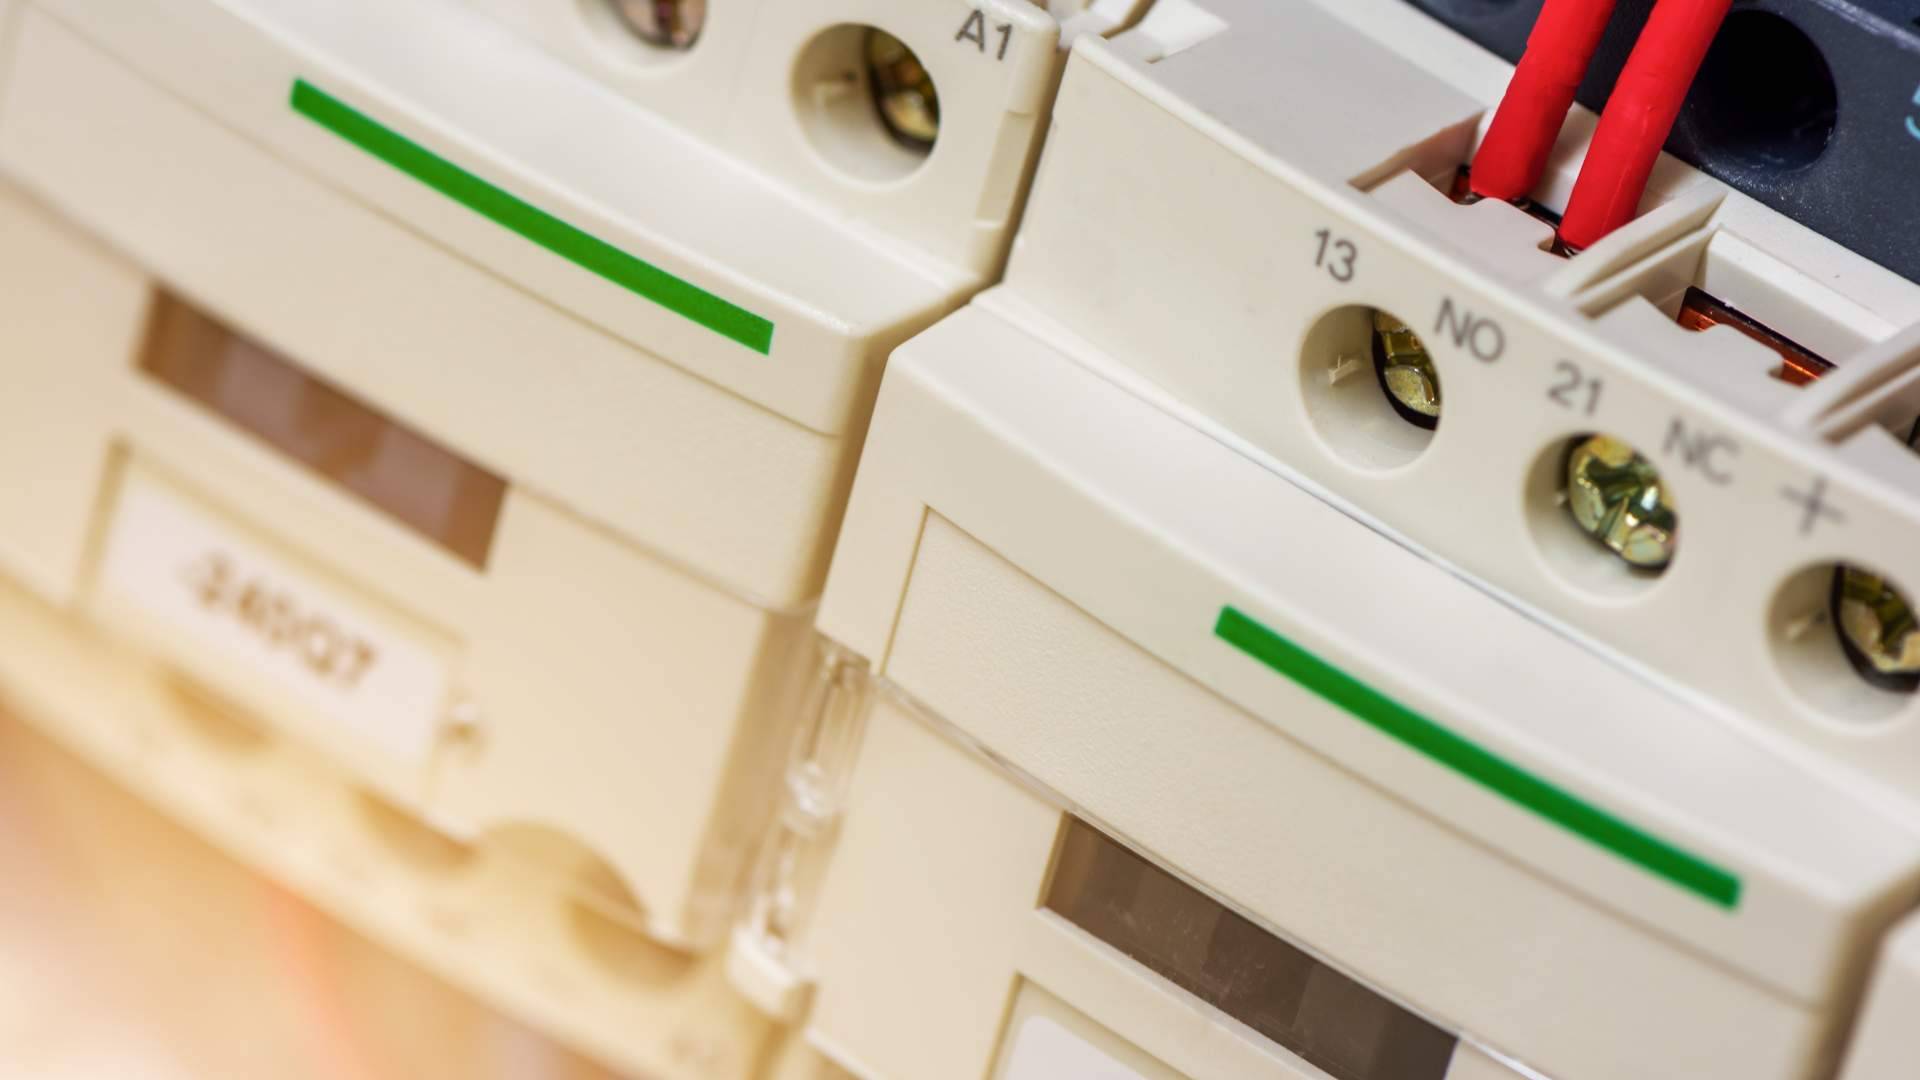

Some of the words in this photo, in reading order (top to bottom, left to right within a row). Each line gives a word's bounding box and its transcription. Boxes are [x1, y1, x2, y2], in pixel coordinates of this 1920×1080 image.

[954, 8, 1012, 61] A1
[1313, 229, 1358, 283] 13
[1435, 299, 1504, 364] NO
[1547, 362, 1602, 413] 21
[1662, 417, 1738, 484] NC
